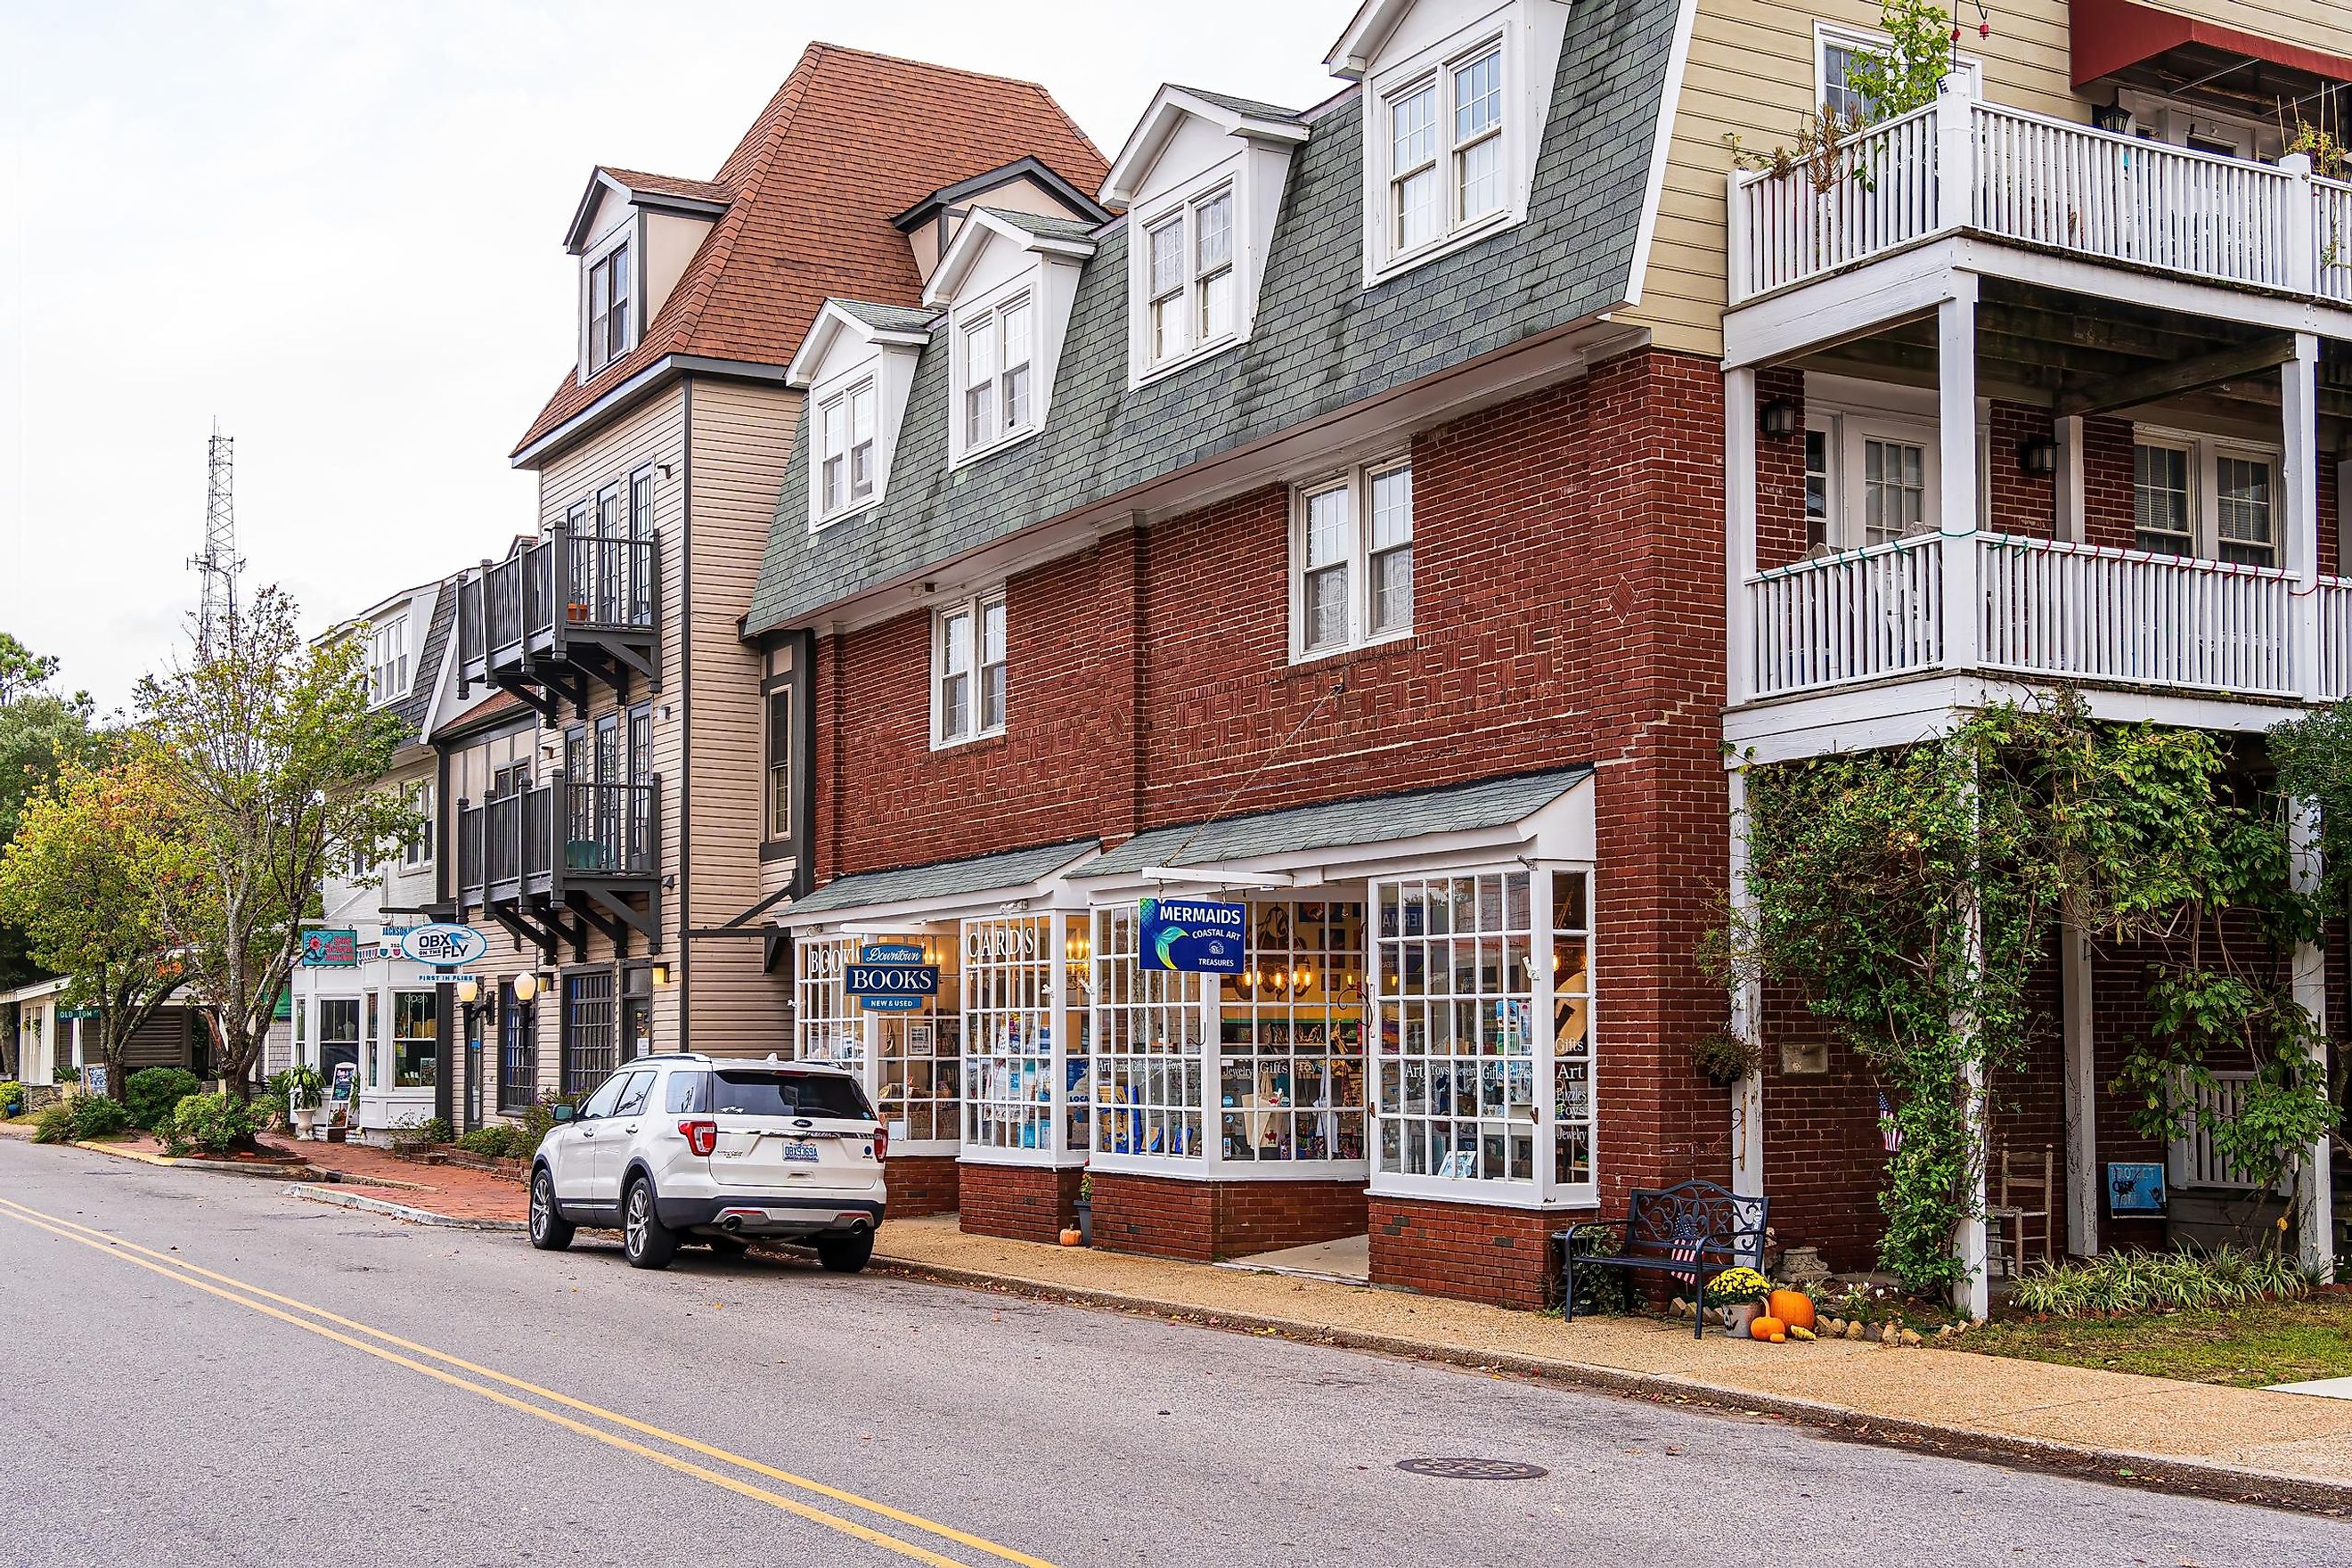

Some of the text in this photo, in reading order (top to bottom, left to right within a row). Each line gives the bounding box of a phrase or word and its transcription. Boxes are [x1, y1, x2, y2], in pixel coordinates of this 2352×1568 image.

[1160, 906, 1241, 925] MERMAIDS
[419, 934, 450, 948] OBX
[968, 927, 1034, 957] CARDS
[1192, 929, 1241, 941] COASTAL ART
[442, 944, 469, 959] FLY
[865, 947, 921, 962] Downtown
[1198, 958, 1235, 967] TREASURES
[852, 969, 932, 990] BOOKS
[404, 995, 429, 1008] open
[1555, 1037, 1584, 1051] Gifts
[1098, 1060, 1112, 1072] Art
[1224, 1066, 1254, 1079] Jewelry
[1260, 1061, 1288, 1074] Gifts
[1405, 1063, 1424, 1078] Art
[1430, 1064, 1450, 1077] Toys
[1482, 1065, 1504, 1080] Gifts
[1556, 1064, 1584, 1080] Art
[1556, 1087, 1586, 1101] Puzzles
[1556, 1104, 1586, 1119] Toys
[1556, 1127, 1587, 1143] Jewelry
